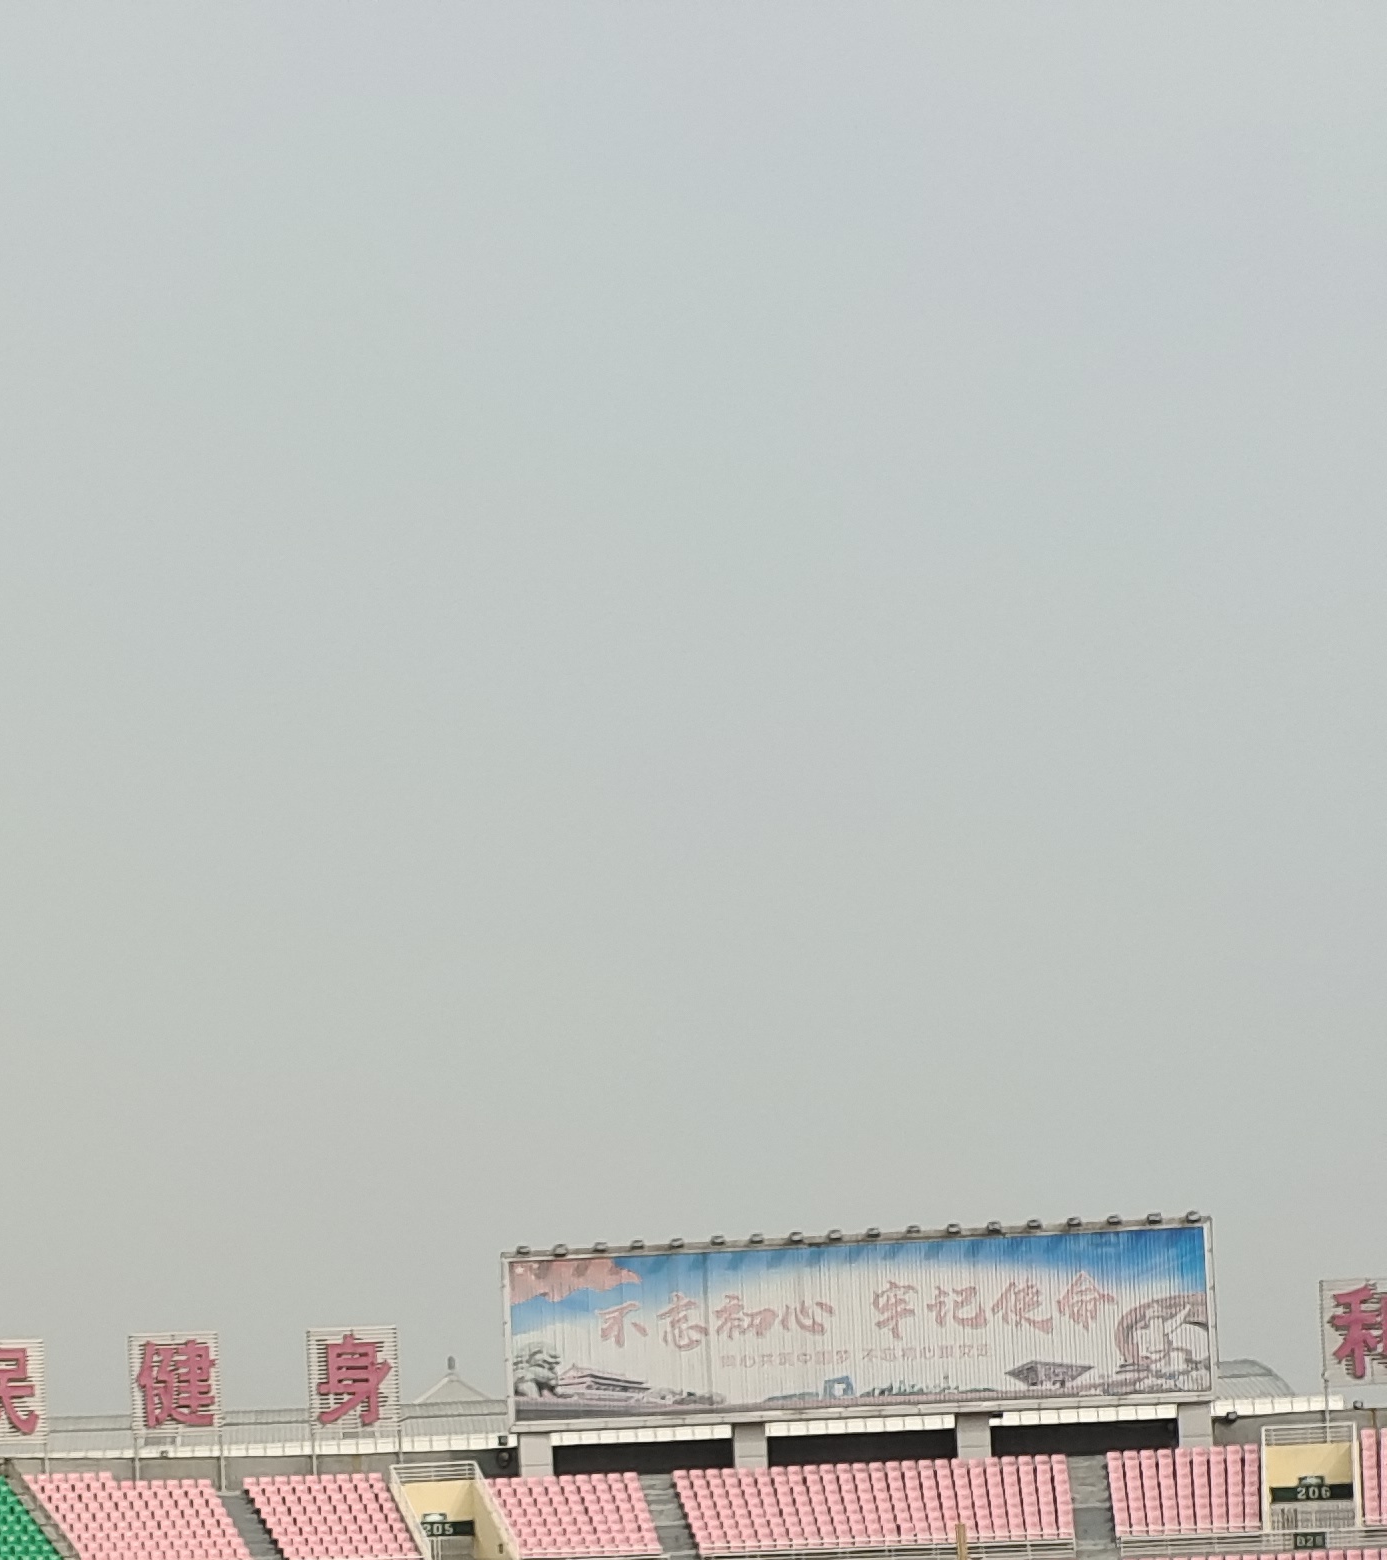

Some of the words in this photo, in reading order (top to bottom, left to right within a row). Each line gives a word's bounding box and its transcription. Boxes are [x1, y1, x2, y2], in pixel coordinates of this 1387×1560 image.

[595, 1291, 836, 1351] 不忘初心
[871, 1270, 1116, 1340] 牢记使命
